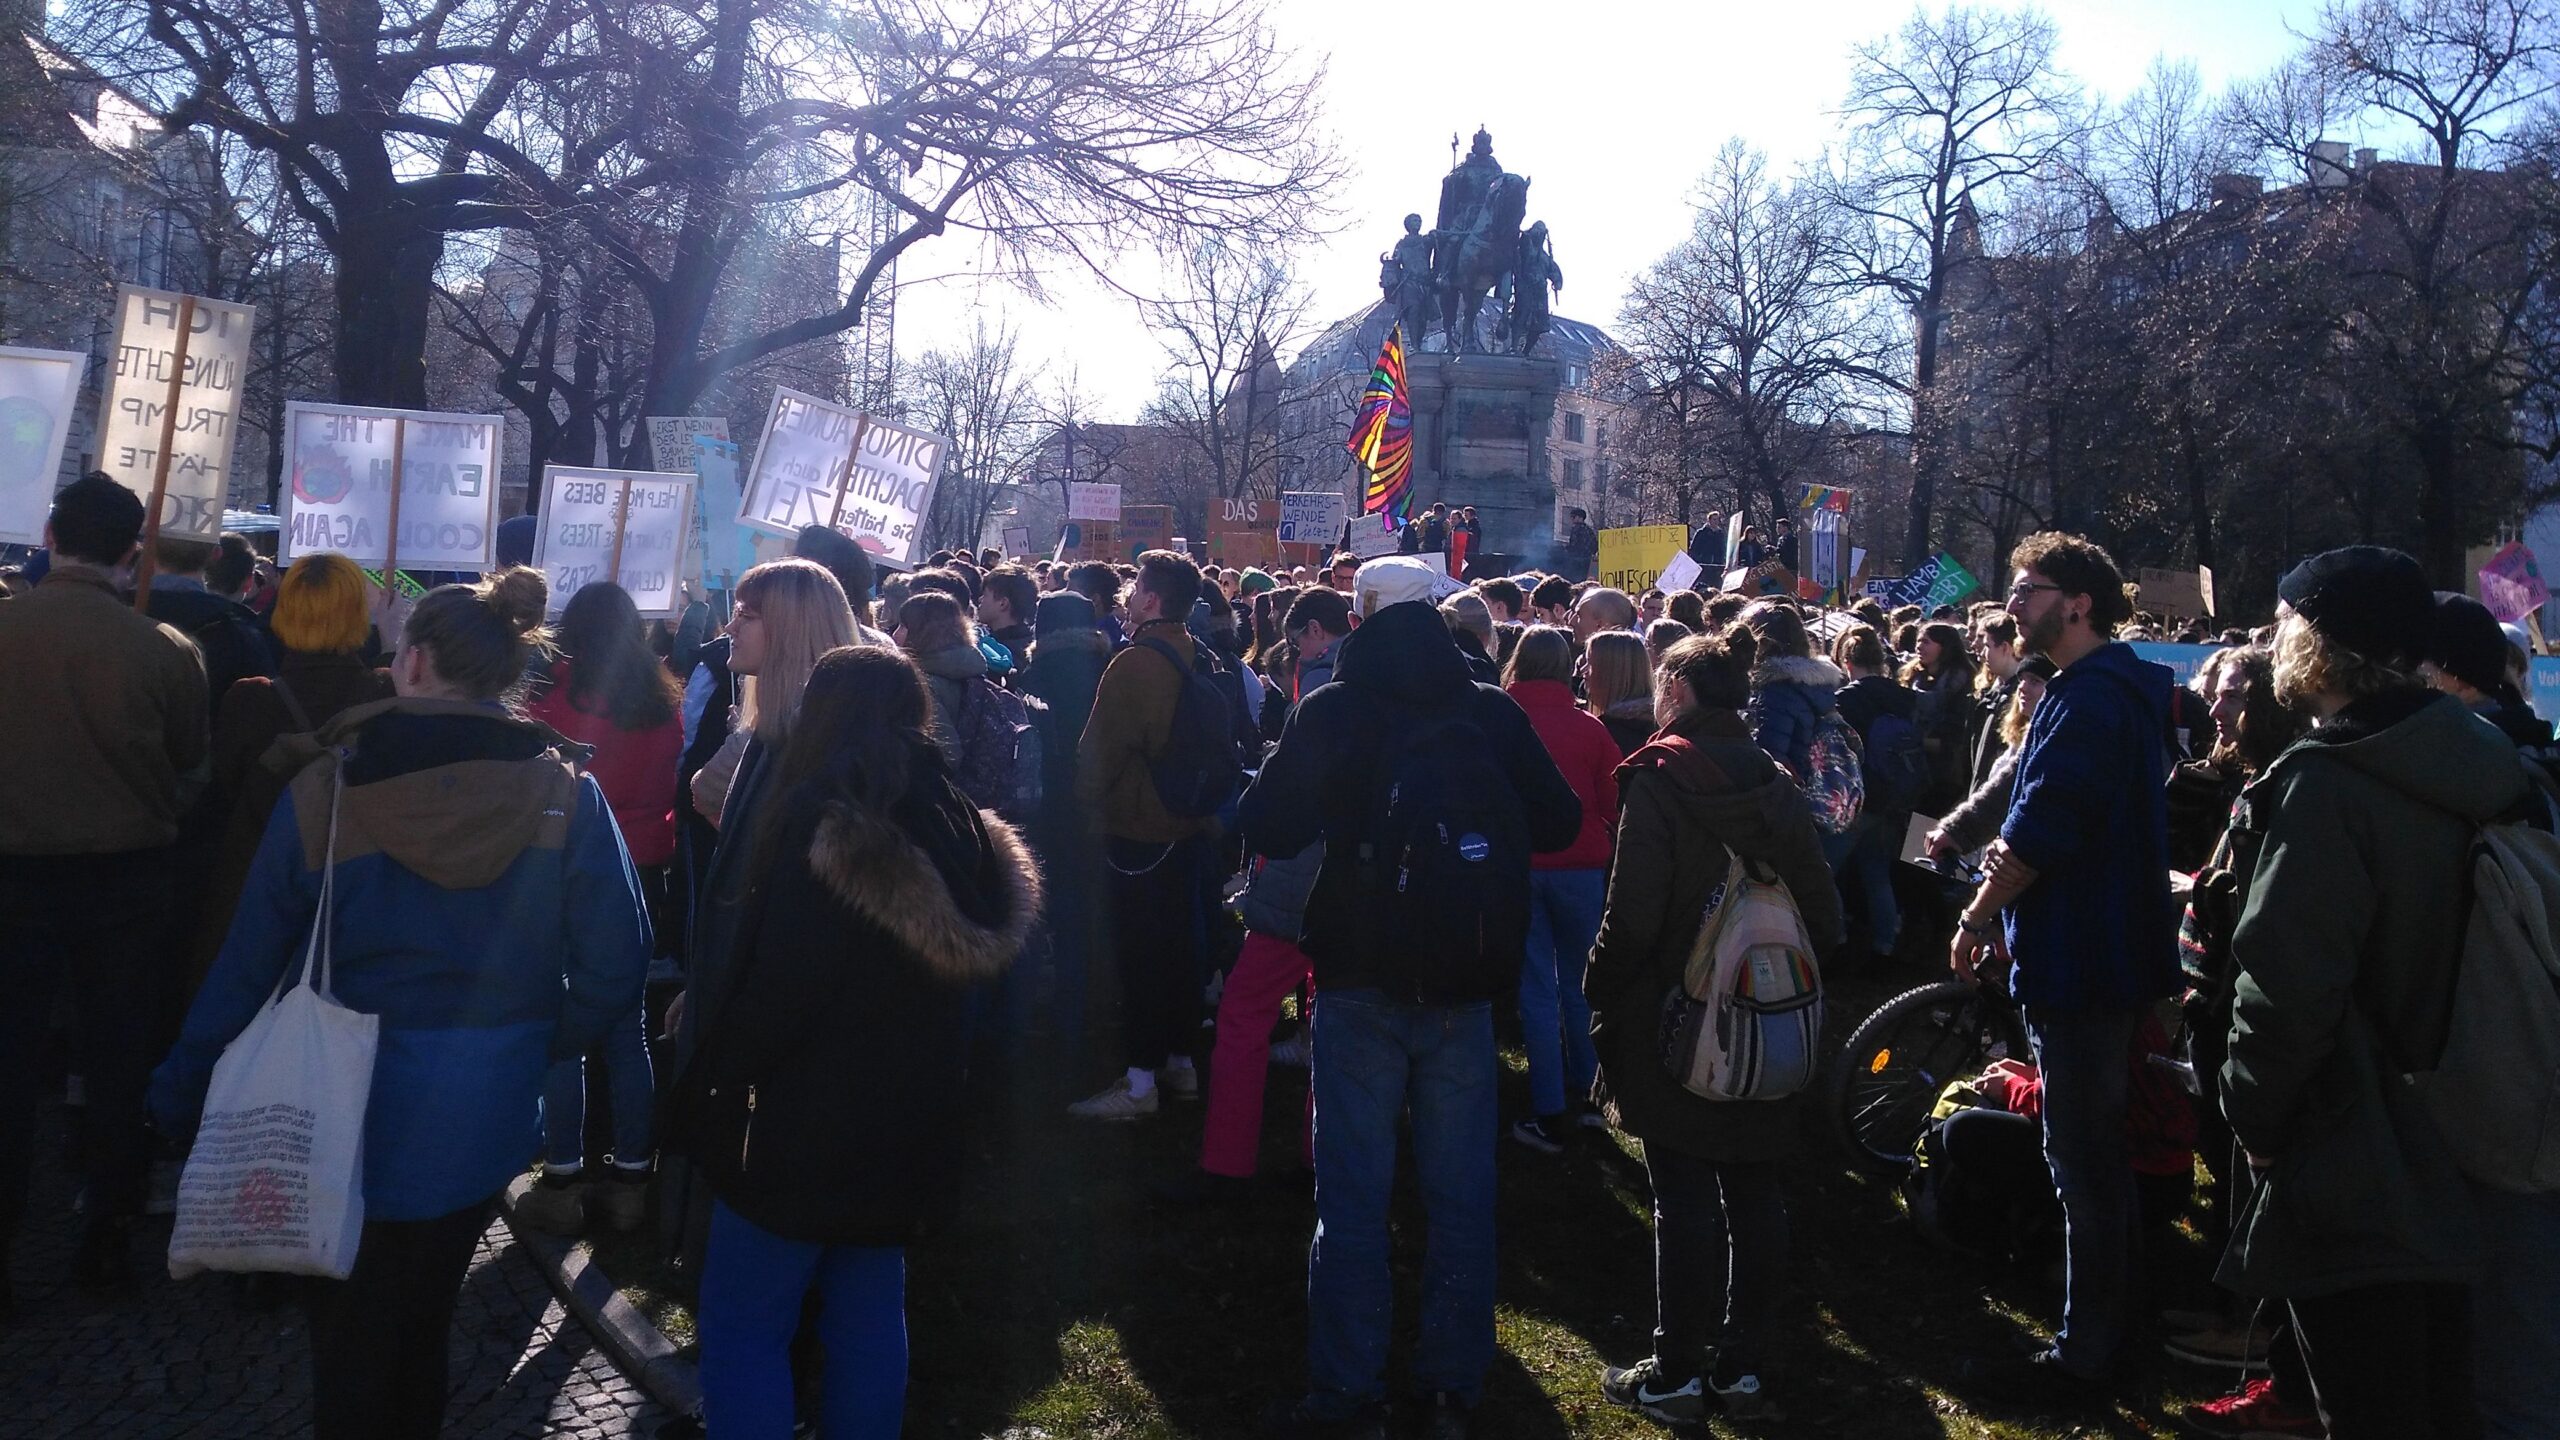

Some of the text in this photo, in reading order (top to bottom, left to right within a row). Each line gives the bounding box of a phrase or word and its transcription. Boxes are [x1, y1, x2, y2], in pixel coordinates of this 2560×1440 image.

[684, 420, 712, 432] WENN
[660, 447, 684, 459] BAUM
[1283, 494, 1340, 509] VERKEHRS-
[1222, 499, 1258, 521] DAS
[1283, 510, 1326, 523] WENDE
